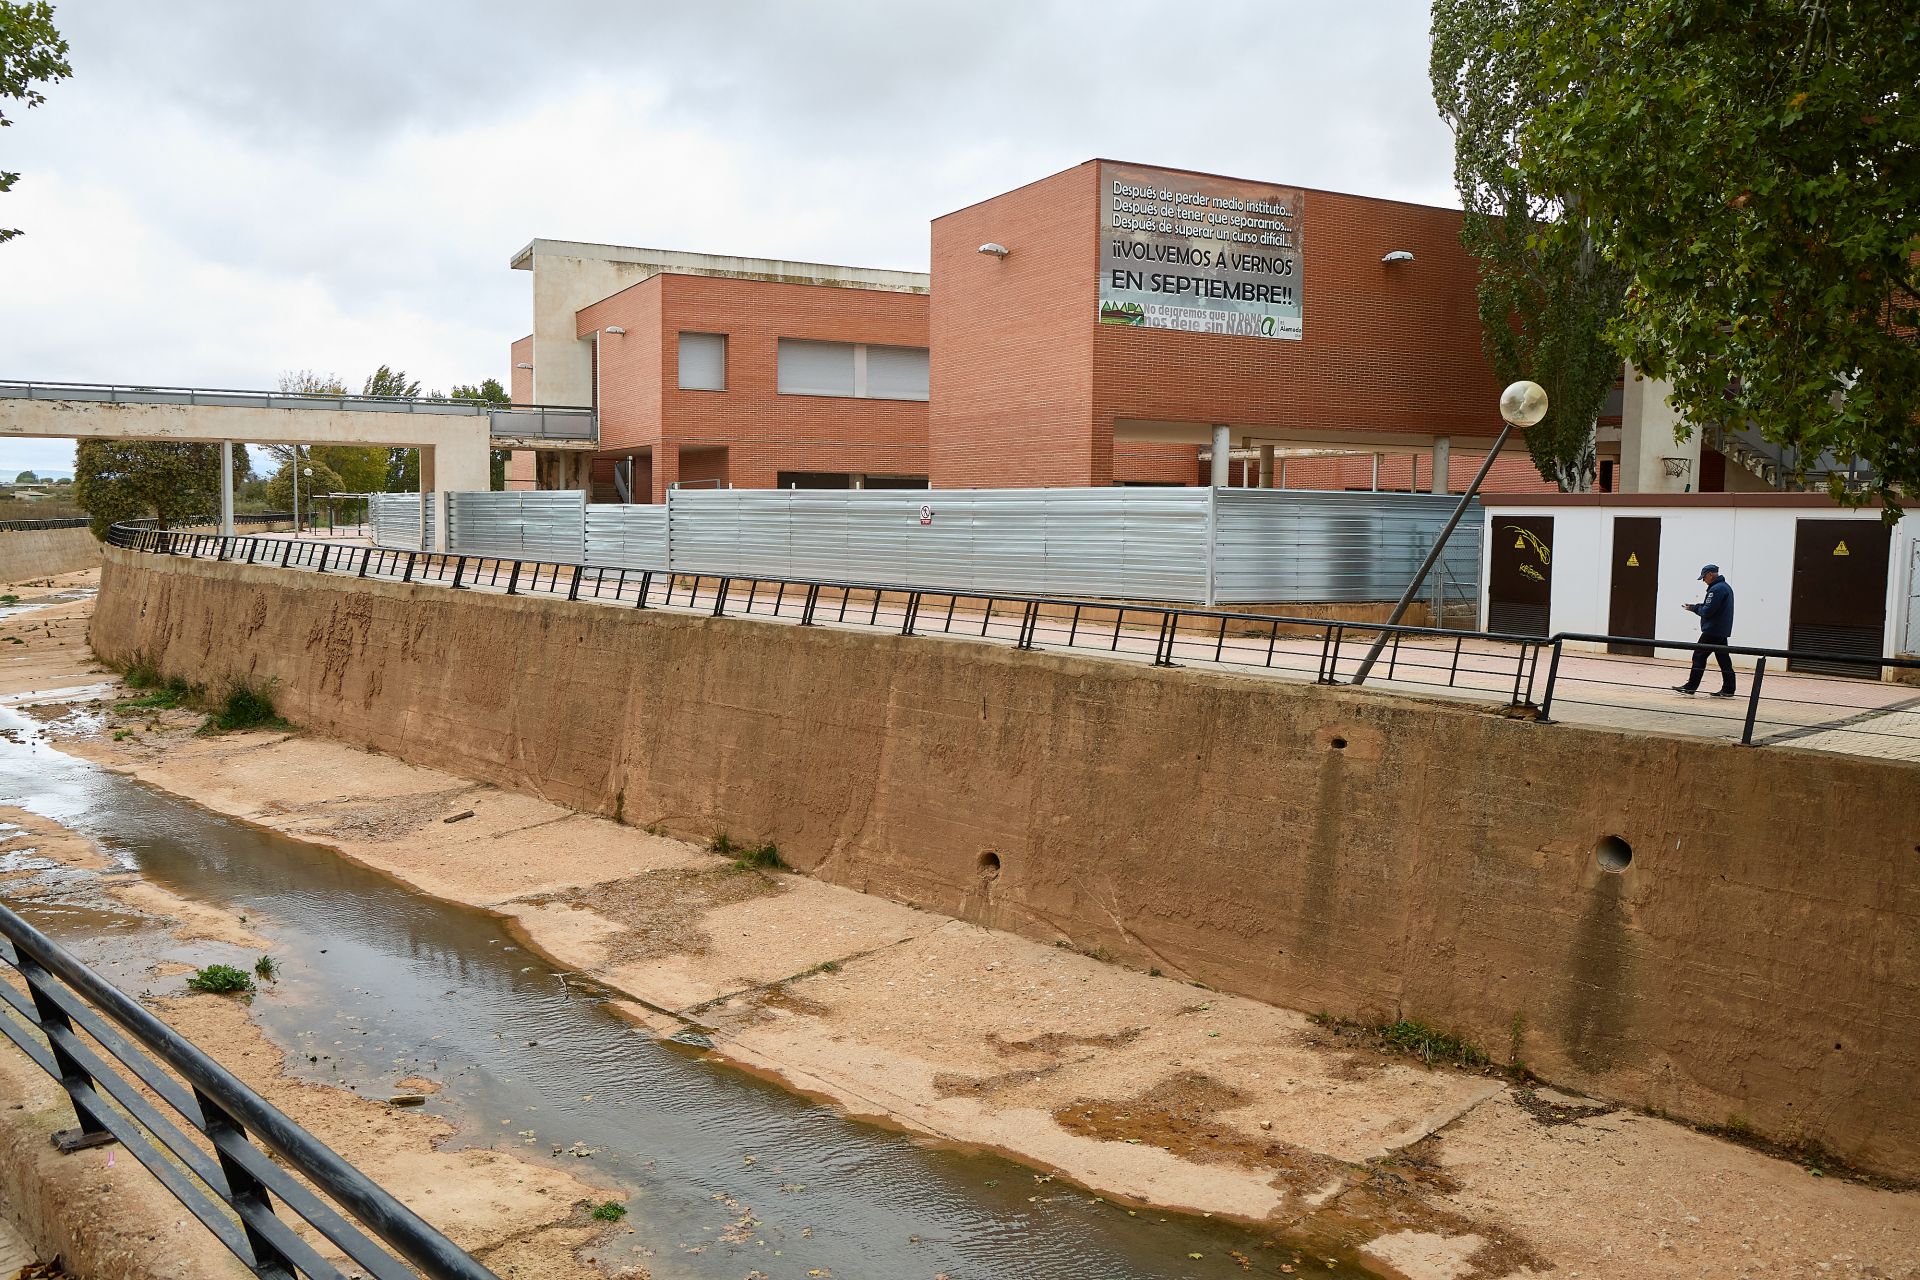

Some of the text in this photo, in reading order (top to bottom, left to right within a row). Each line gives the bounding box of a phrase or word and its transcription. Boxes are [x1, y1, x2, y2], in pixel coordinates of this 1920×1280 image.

[1112, 180, 1293, 217] Después de perder medio instituto...
[1113, 197, 1292, 232] Después de tener que separarnos...
[1112, 213, 1292, 248] Después de superar un curso difícil...
[1215, 252, 1227, 270] A
[1231, 253, 1293, 276] VERNOS
[1112, 269, 1292, 306] EN SEPTIEMBRE!!
[1144, 304, 1156, 315] No
[1158, 305, 1207, 319] dejaremos
[1209, 310, 1226, 321] que
[1228, 311, 1237, 321] la
[1144, 316, 1262, 337] nos deje sin NADA
